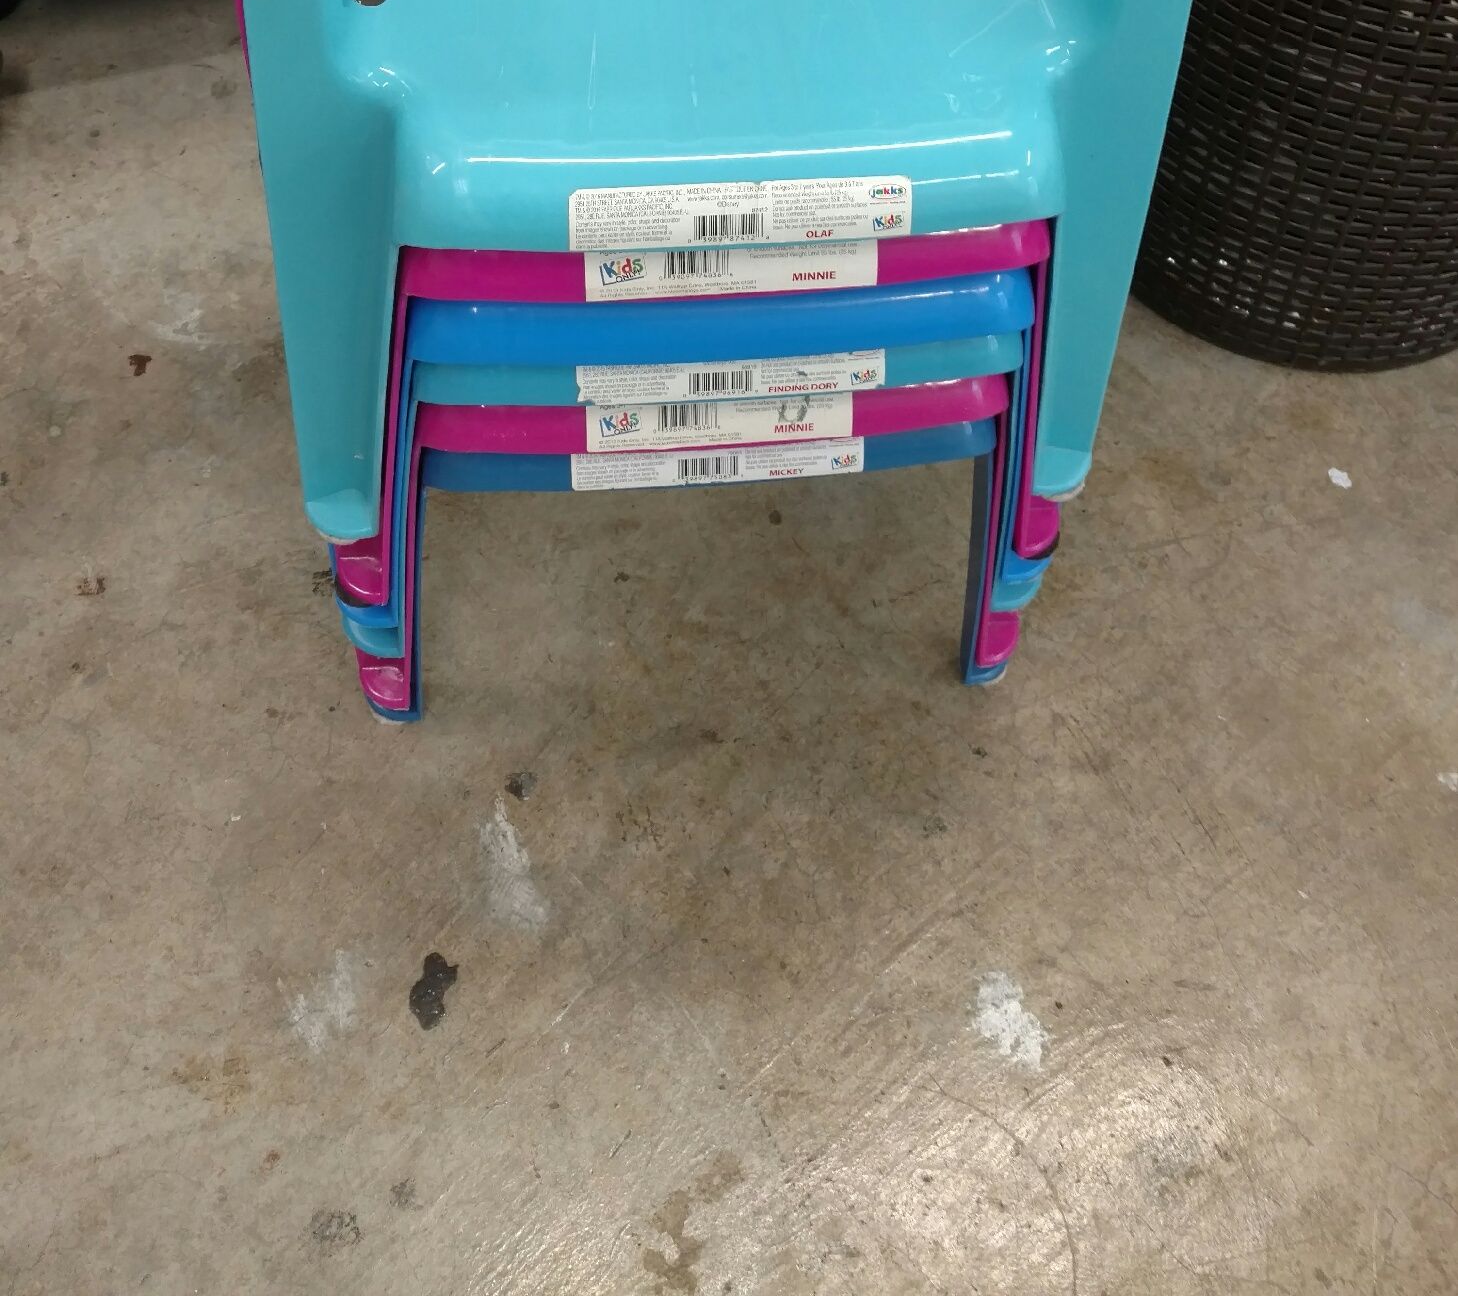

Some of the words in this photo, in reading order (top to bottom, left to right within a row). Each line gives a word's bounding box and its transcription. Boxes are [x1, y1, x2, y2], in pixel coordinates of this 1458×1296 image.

[871, 186, 903, 198] jakks
[875, 214, 902, 227] Kids
[806, 230, 834, 238] OLAF
[603, 258, 644, 278] Kids
[792, 271, 836, 281] MINNIE
[853, 369, 877, 381] Kids
[768, 384, 809, 393] FINDING
[811, 382, 839, 391] DORY
[603, 412, 639, 430] Kids
[774, 423, 814, 433] MINNIE
[833, 454, 858, 466] Kids
[770, 468, 804, 476] MICKEY
